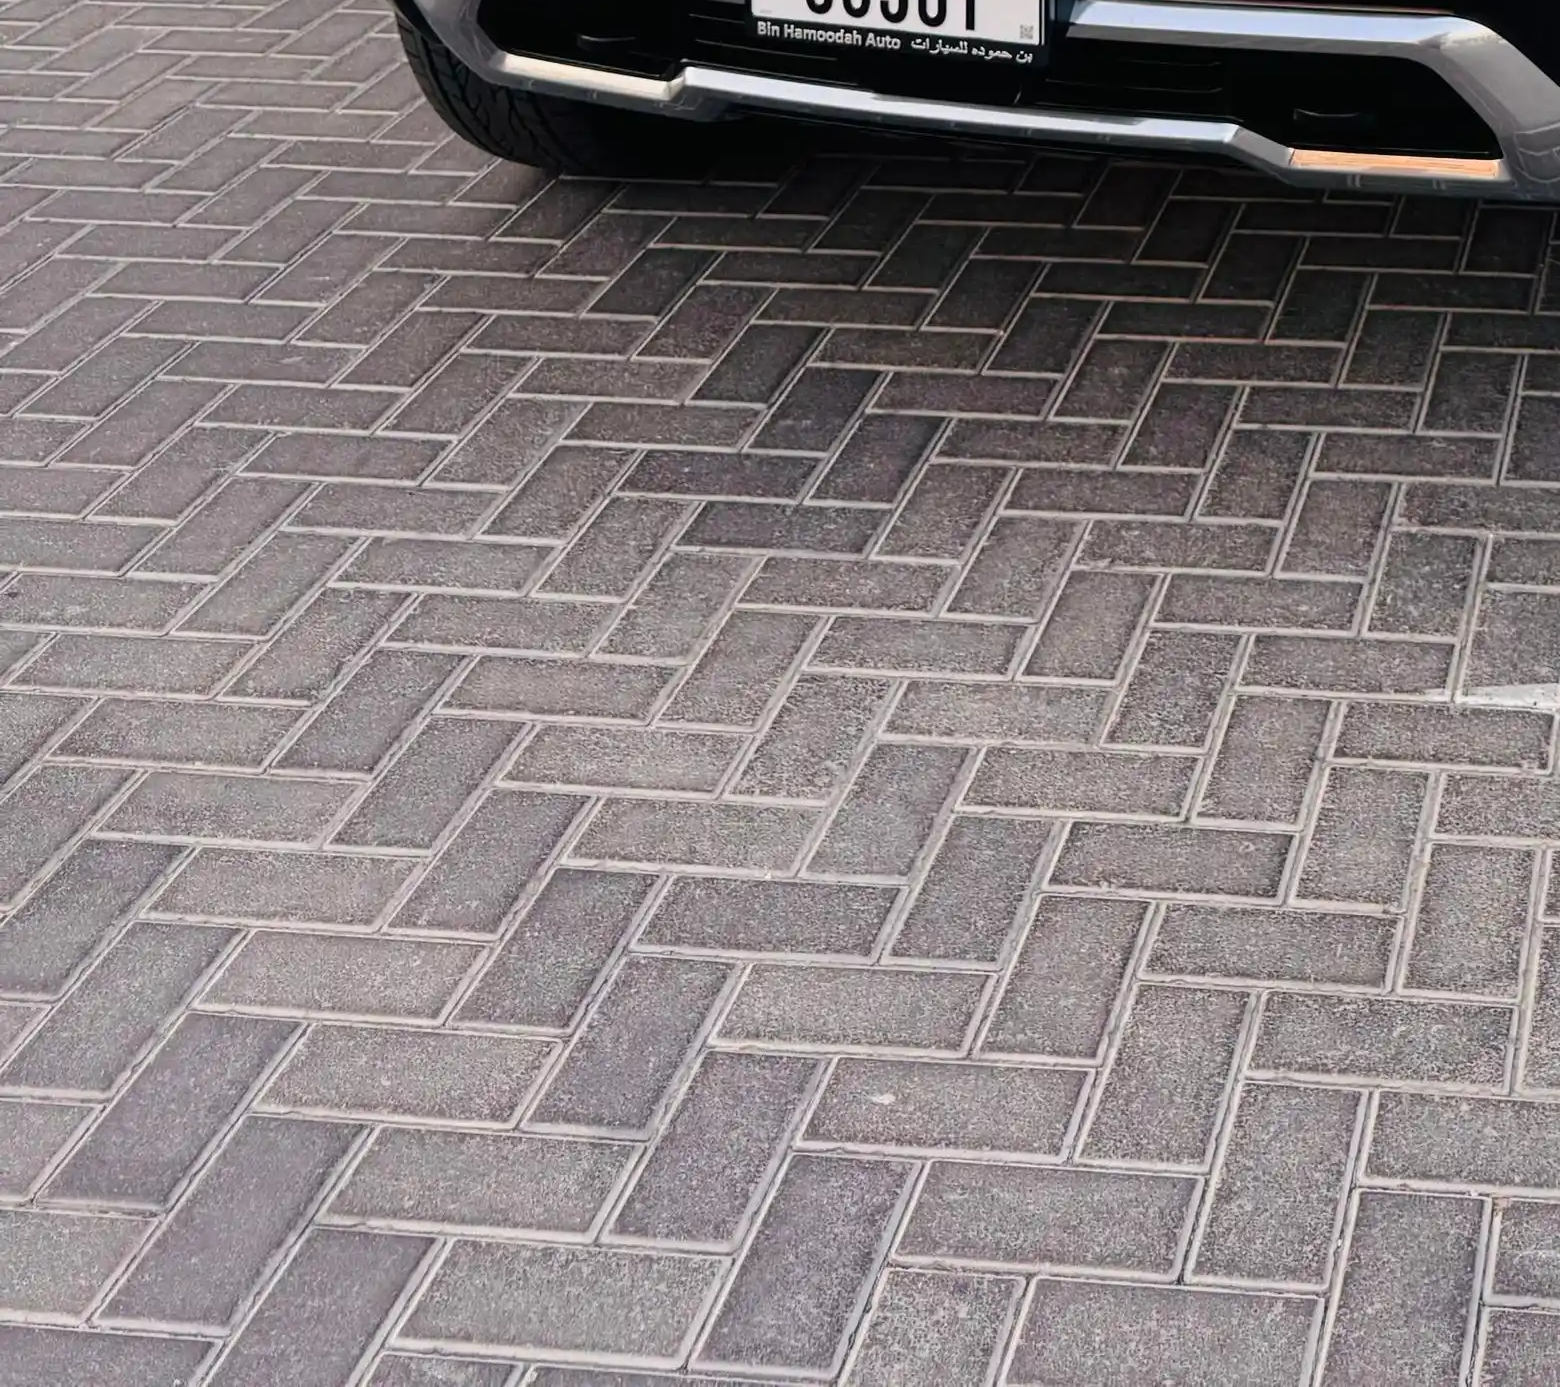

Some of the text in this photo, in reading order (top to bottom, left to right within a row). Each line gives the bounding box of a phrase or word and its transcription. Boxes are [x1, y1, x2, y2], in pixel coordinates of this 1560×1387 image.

[757, 21, 902, 50] Bin Hamoodah Auto
